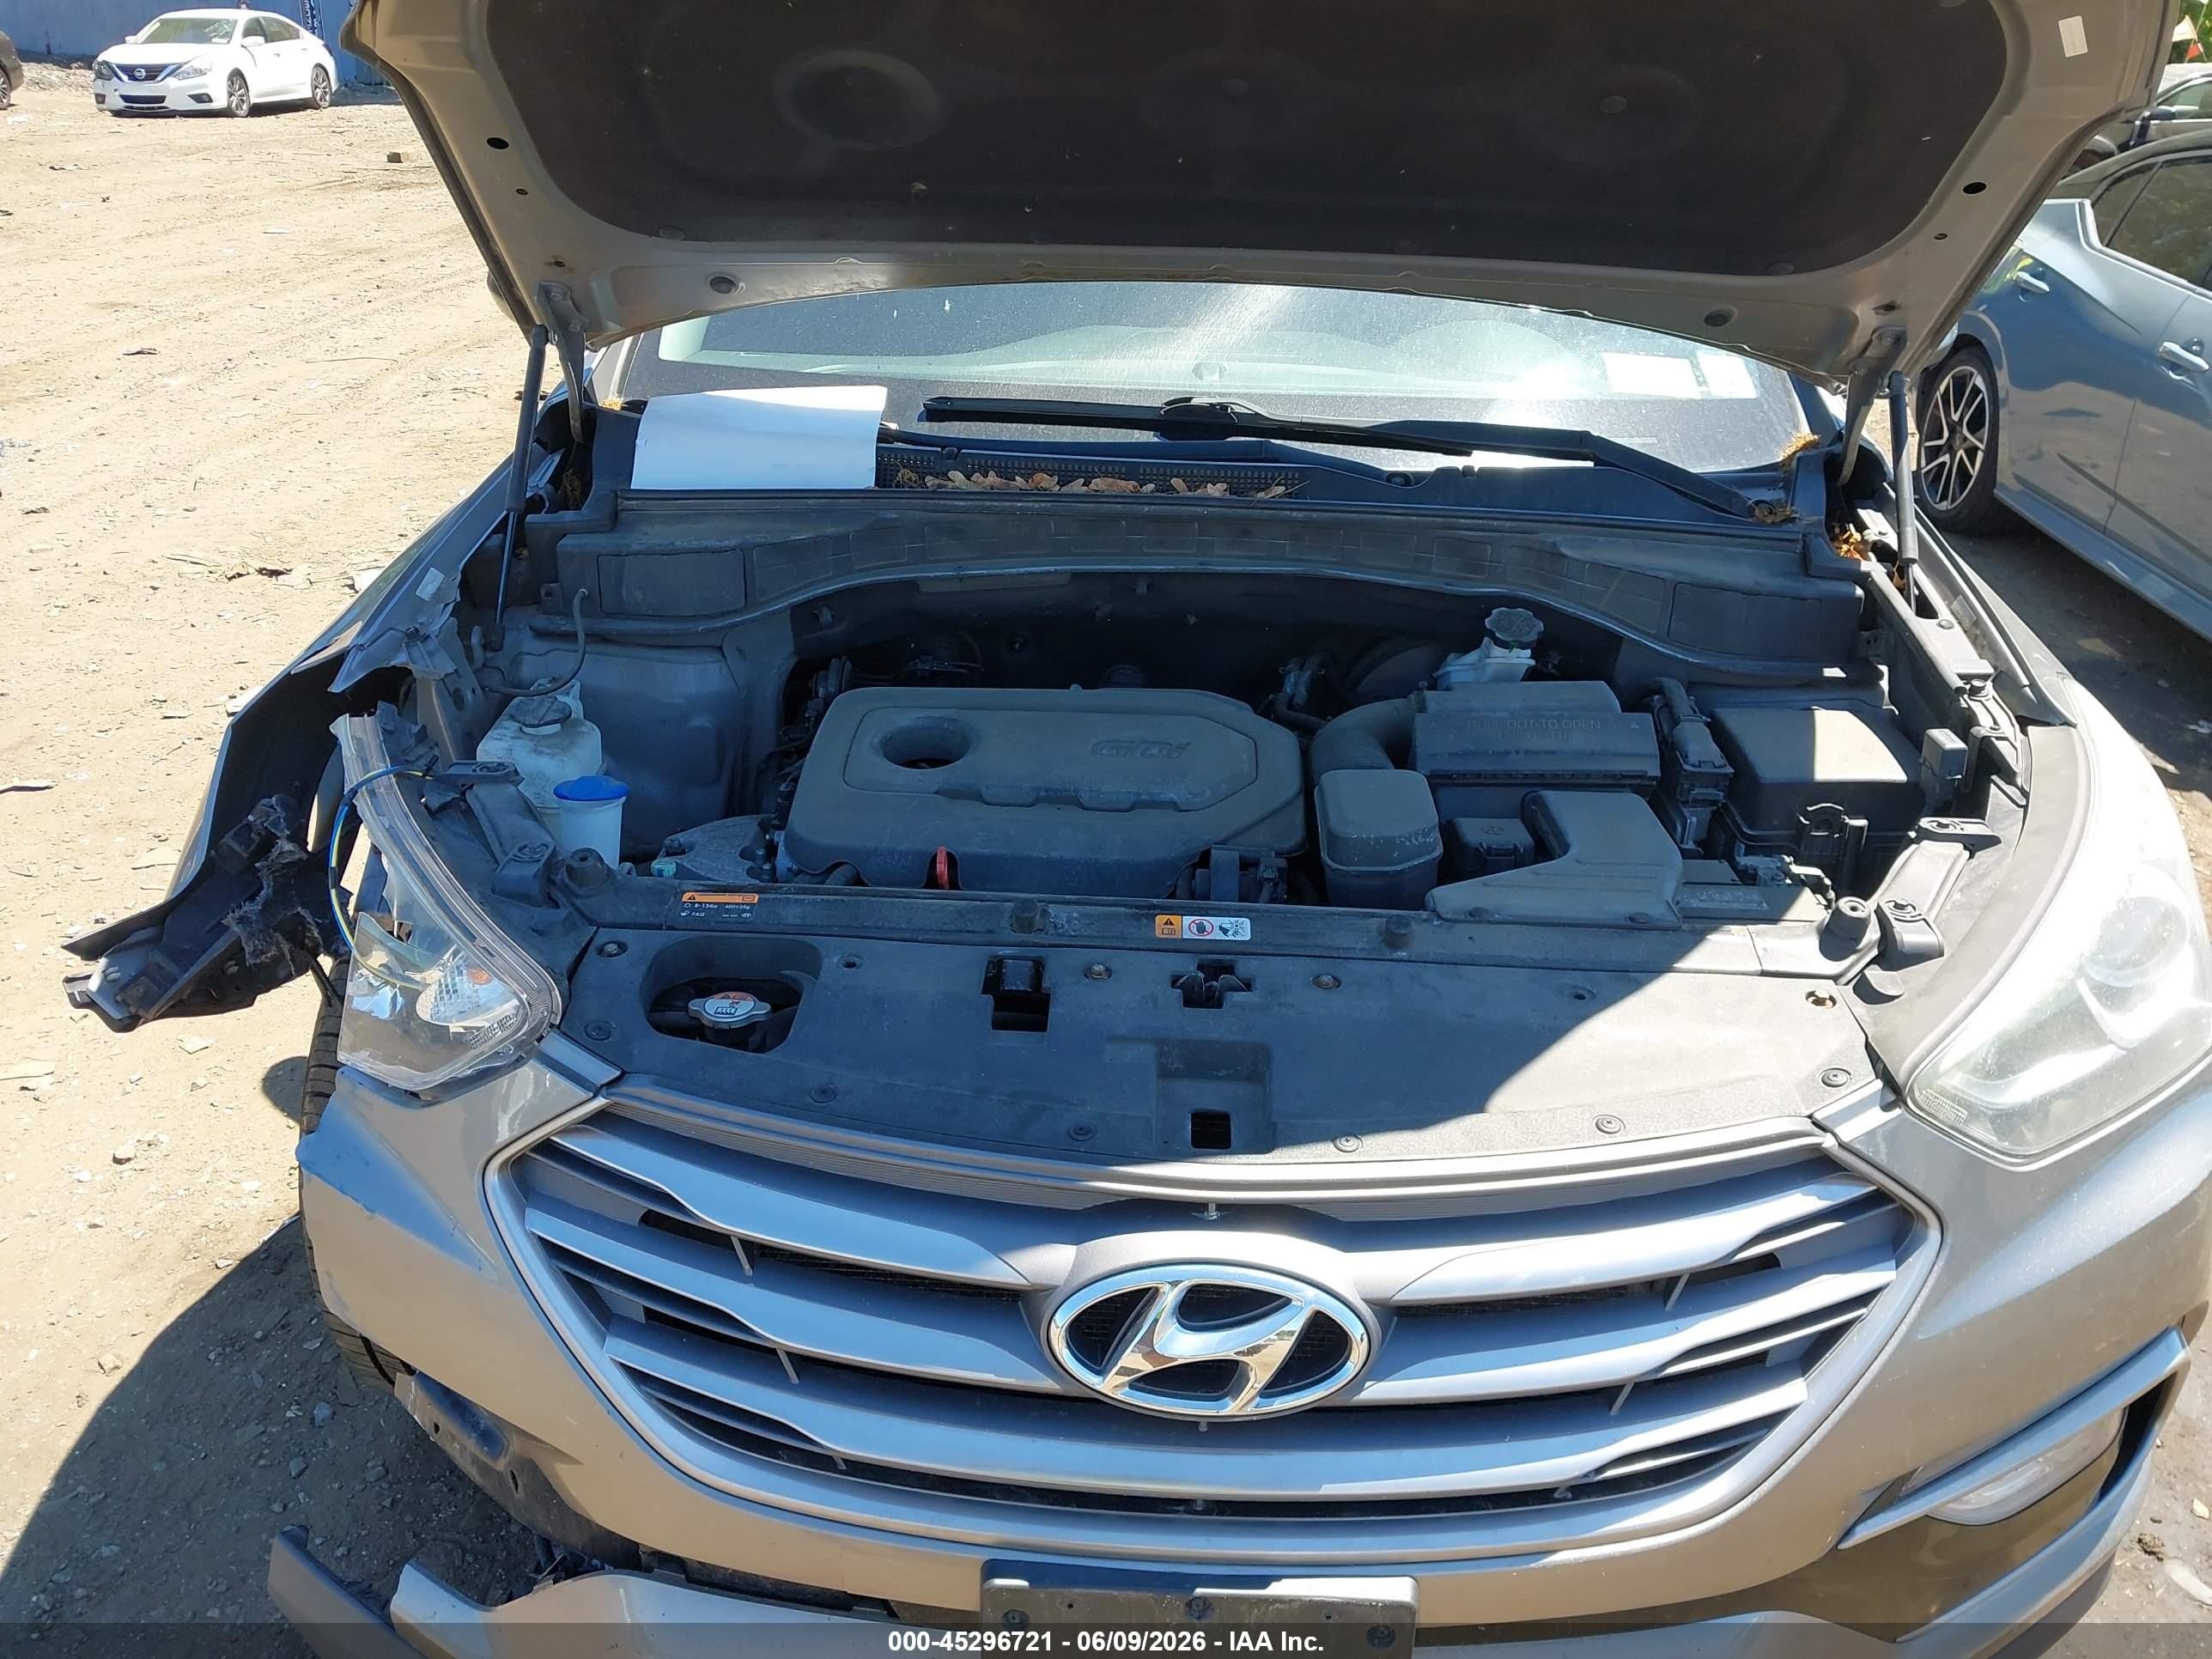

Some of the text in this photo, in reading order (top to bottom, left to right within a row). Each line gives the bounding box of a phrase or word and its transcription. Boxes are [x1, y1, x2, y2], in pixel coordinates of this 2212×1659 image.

[1507, 720, 1536, 730] OUT
[1540, 719, 1559, 730] TO
[1562, 720, 1601, 730] OPEN
